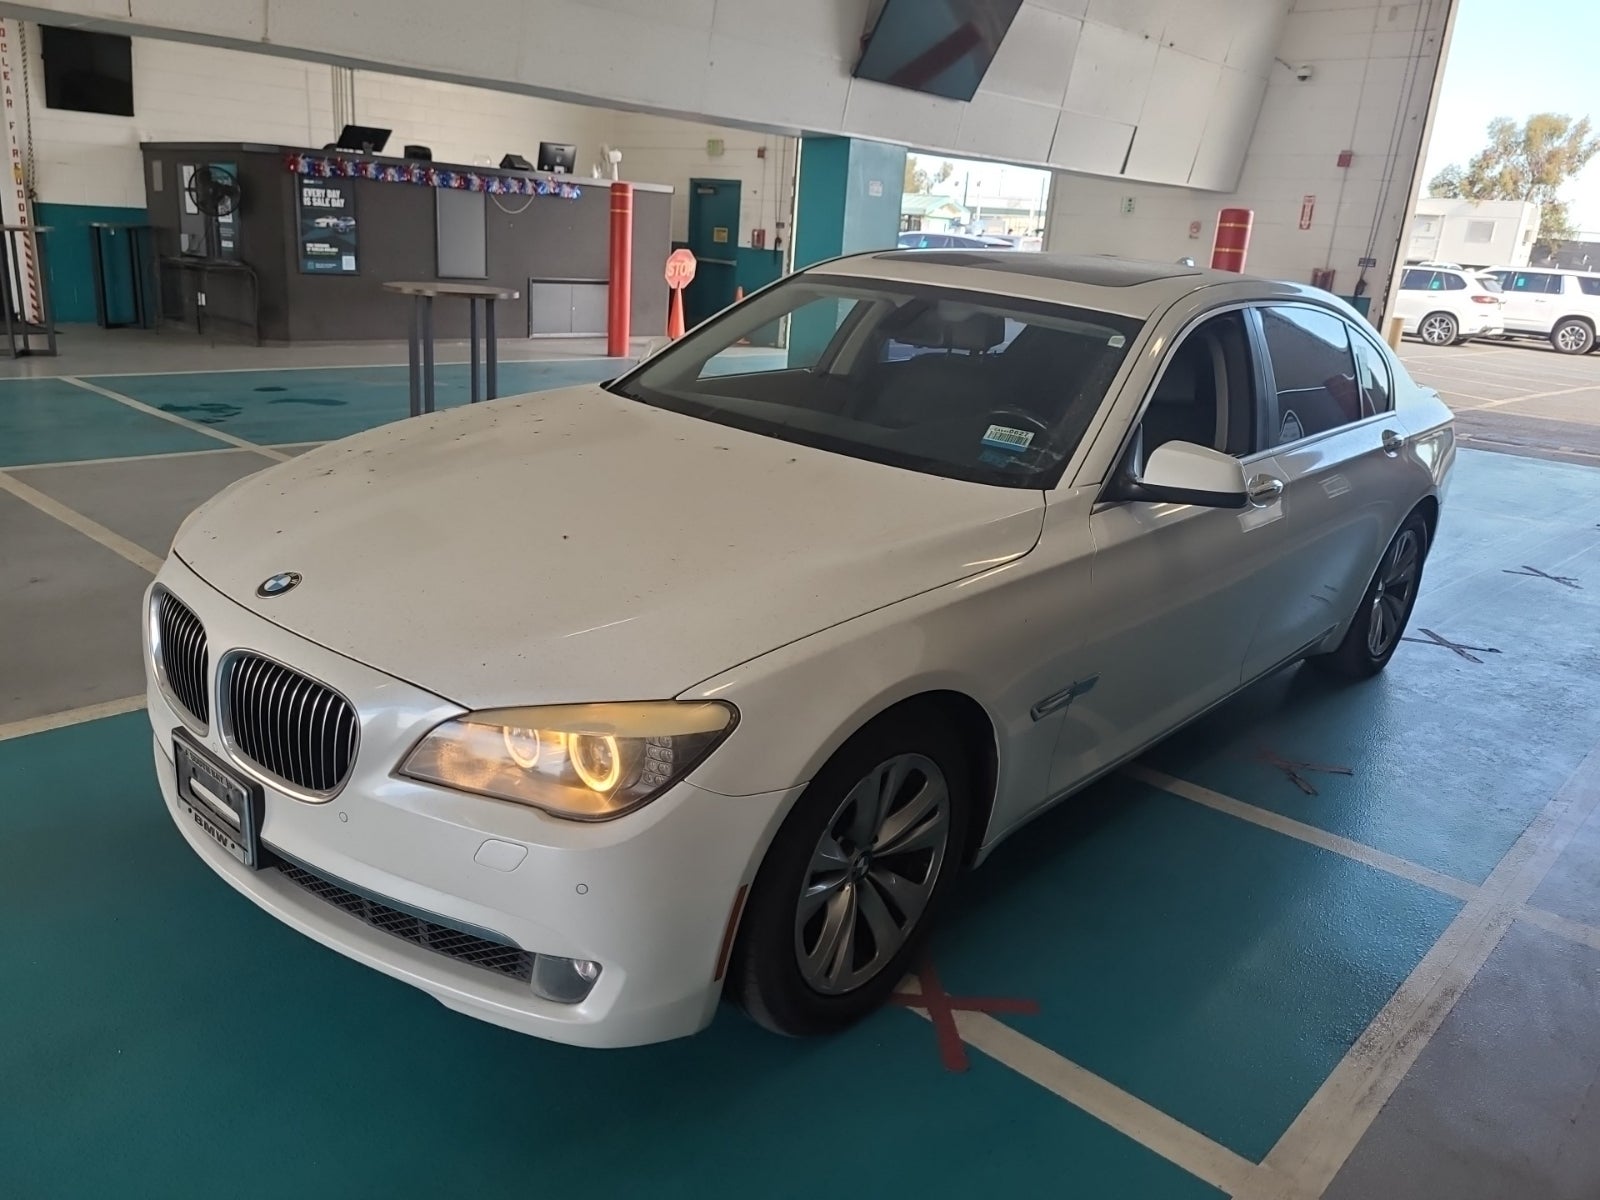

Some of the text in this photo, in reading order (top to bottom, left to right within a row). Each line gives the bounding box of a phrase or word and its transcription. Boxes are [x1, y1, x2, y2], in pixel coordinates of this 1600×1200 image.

[1, 43, 13, 108] CLEAR
[303, 188, 341, 198] EVERY DAY
[303, 197, 345, 208] IS SALE DAY
[667, 262, 693, 277] STOP
[195, 813, 228, 847] BMW
